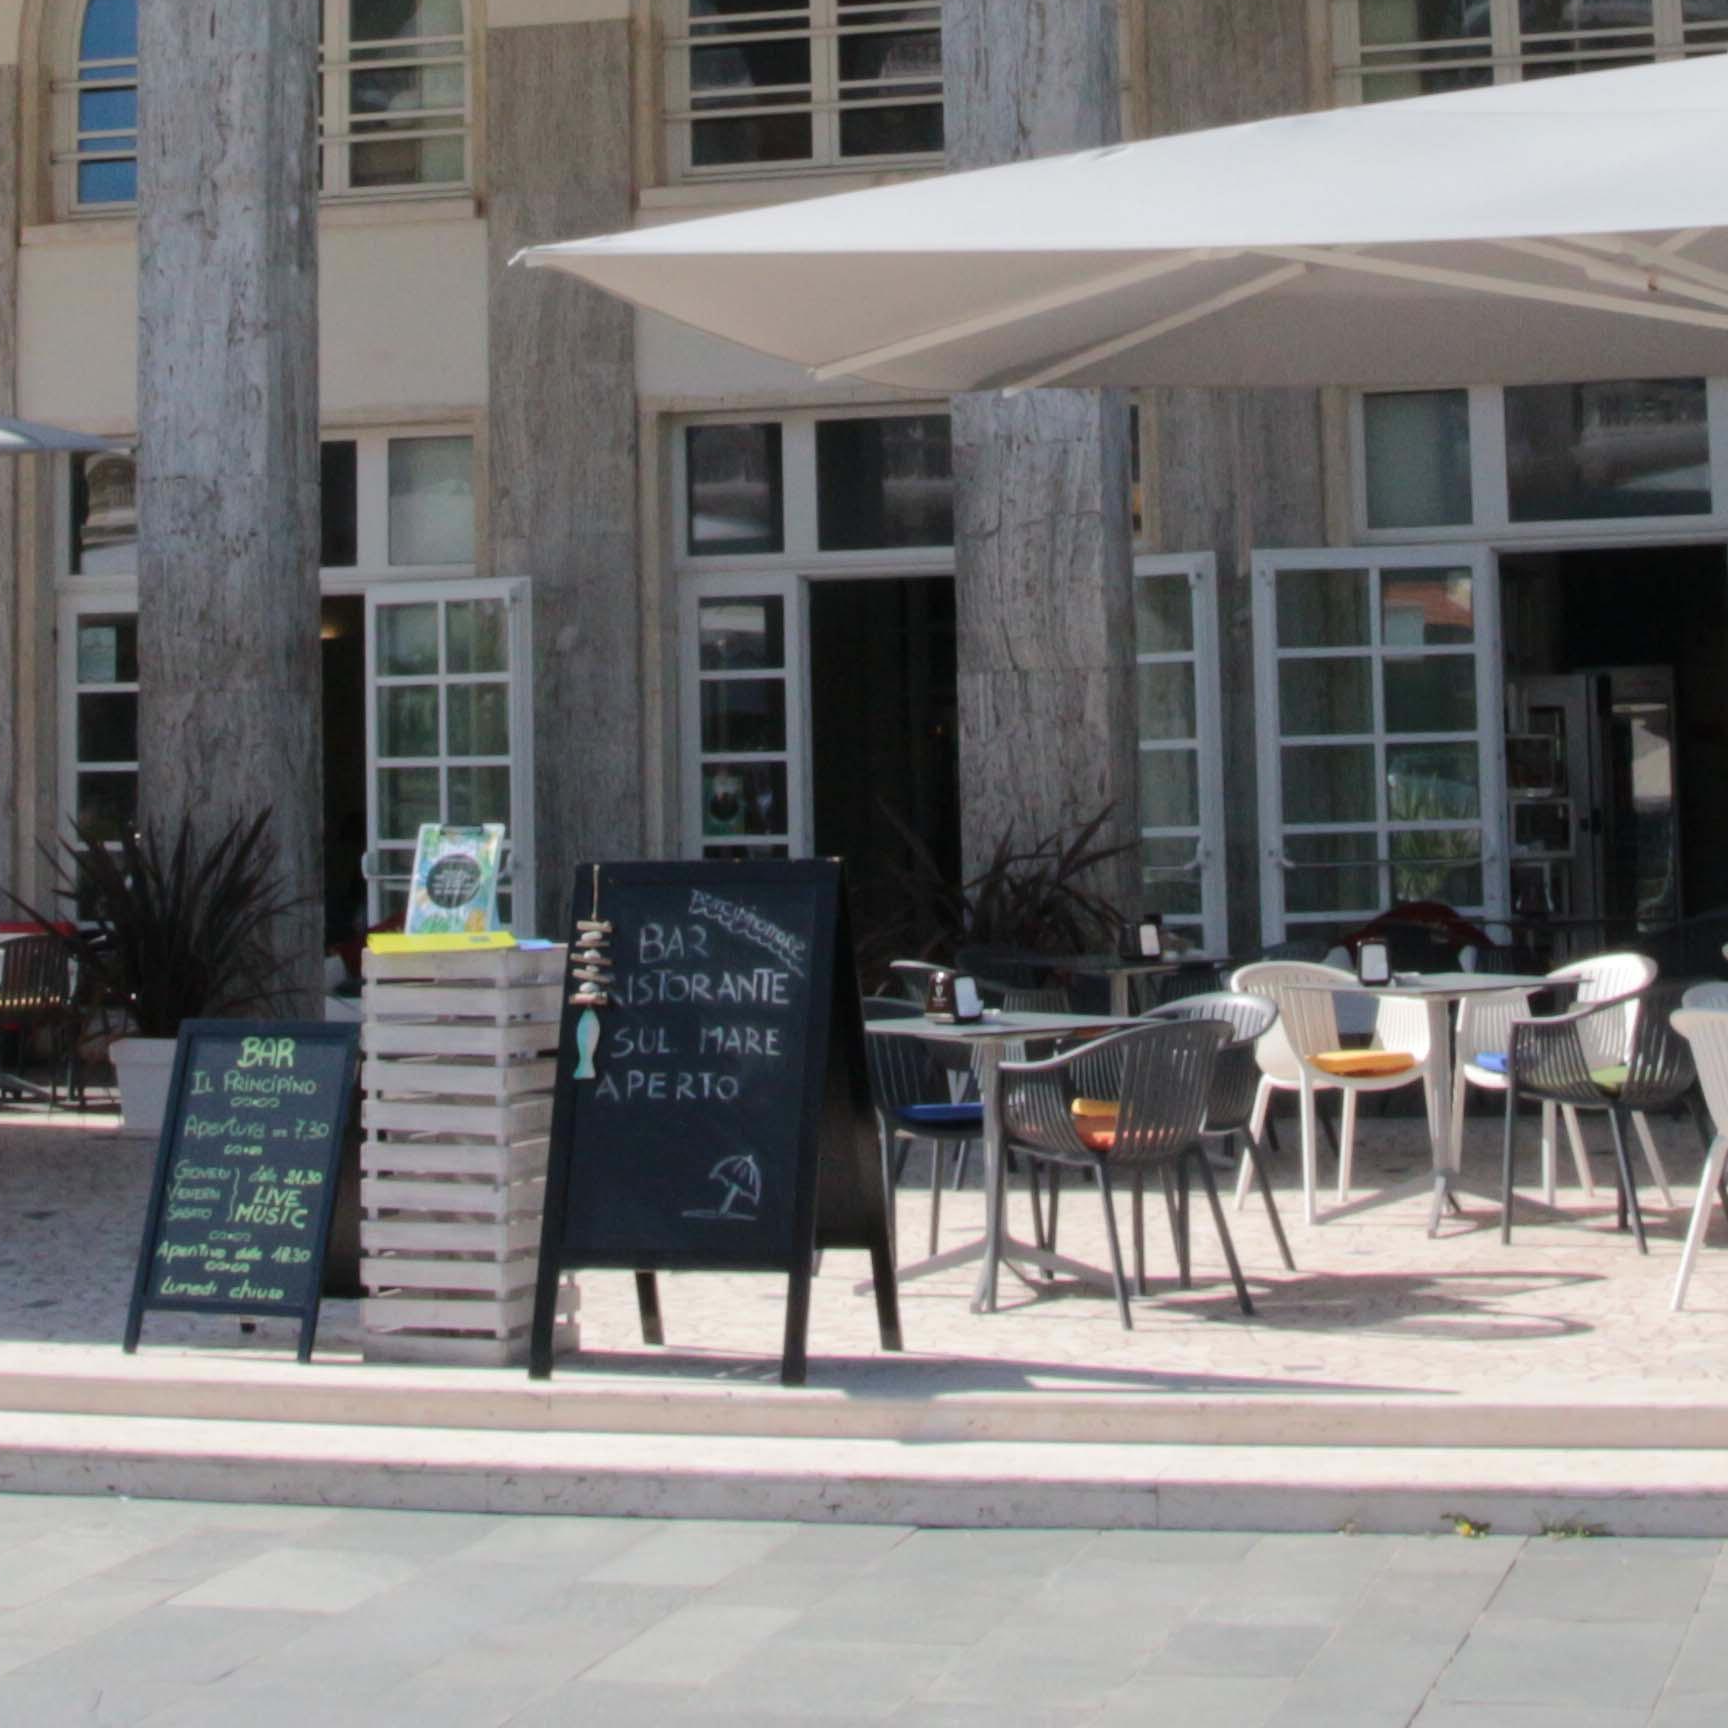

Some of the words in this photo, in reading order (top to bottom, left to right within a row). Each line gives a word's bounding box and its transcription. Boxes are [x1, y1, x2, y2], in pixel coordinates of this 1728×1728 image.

[638, 923, 710, 964] BAR
[237, 1036, 296, 1069] BAR
[610, 1026, 672, 1059] SUL
[699, 1025, 782, 1056] MARE
[594, 1070, 740, 1101] APERTO
[183, 1114, 266, 1140] Apertura
[252, 1185, 303, 1207] LIVE
[234, 1203, 309, 1229] MUSIC
